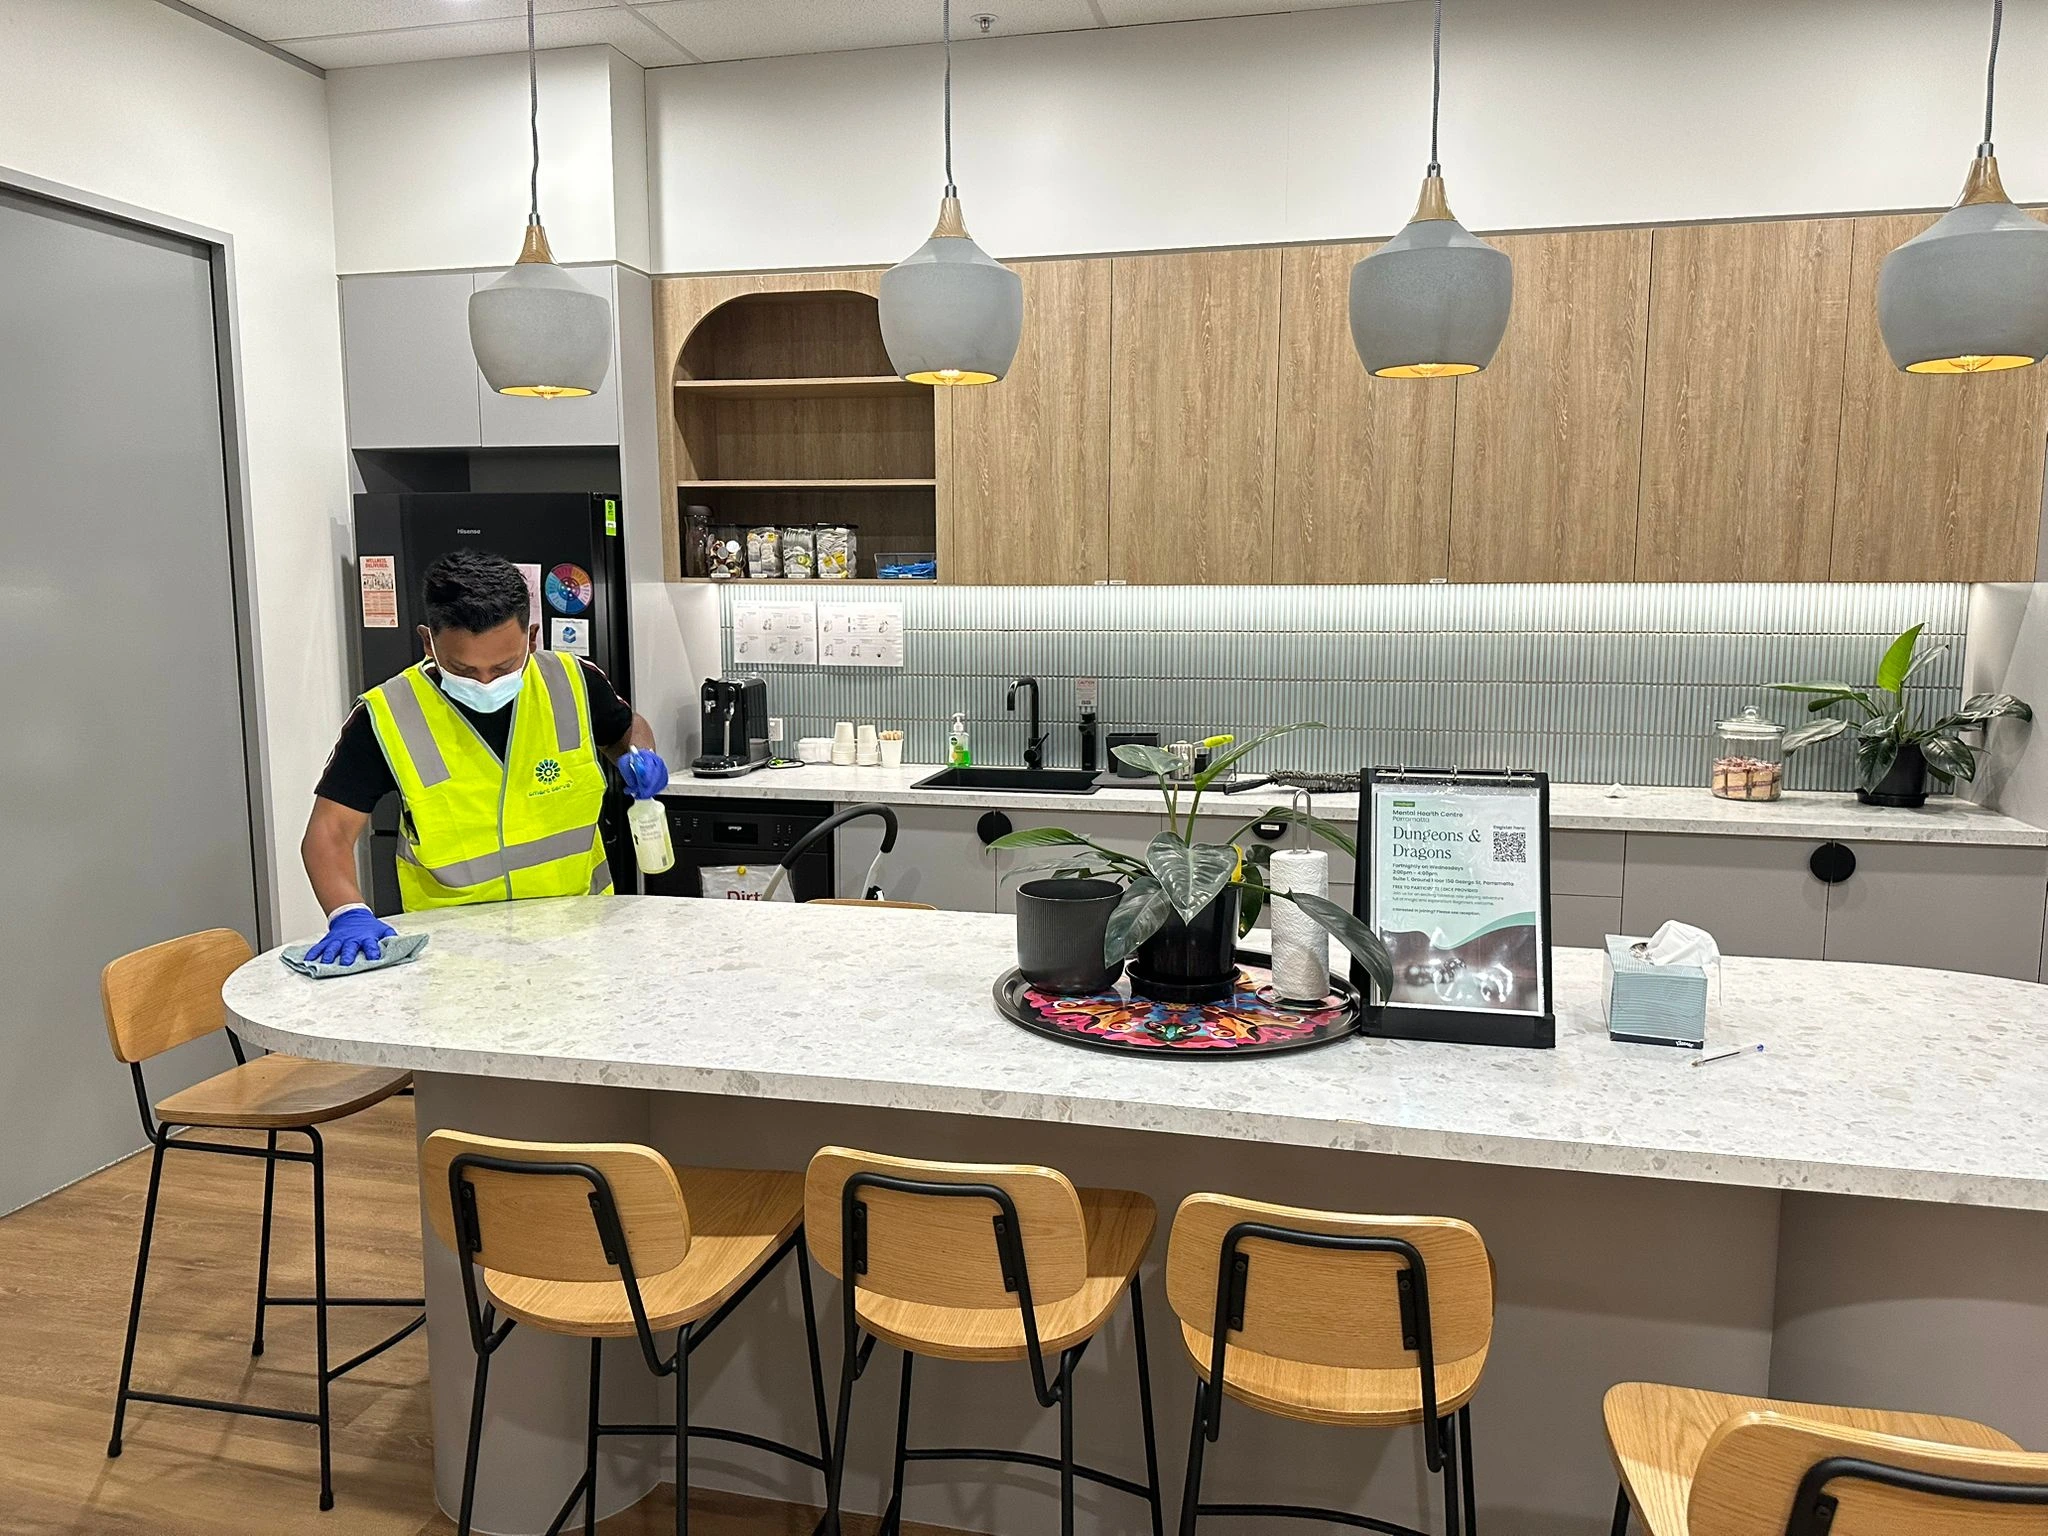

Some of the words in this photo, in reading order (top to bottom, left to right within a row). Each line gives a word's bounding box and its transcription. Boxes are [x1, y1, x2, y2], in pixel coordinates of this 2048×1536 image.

[1393, 826, 1464, 843] Dungeons
[1468, 828, 1482, 842] &
[1393, 844, 1452, 860] Dragons
[727, 890, 763, 901] Dirt
